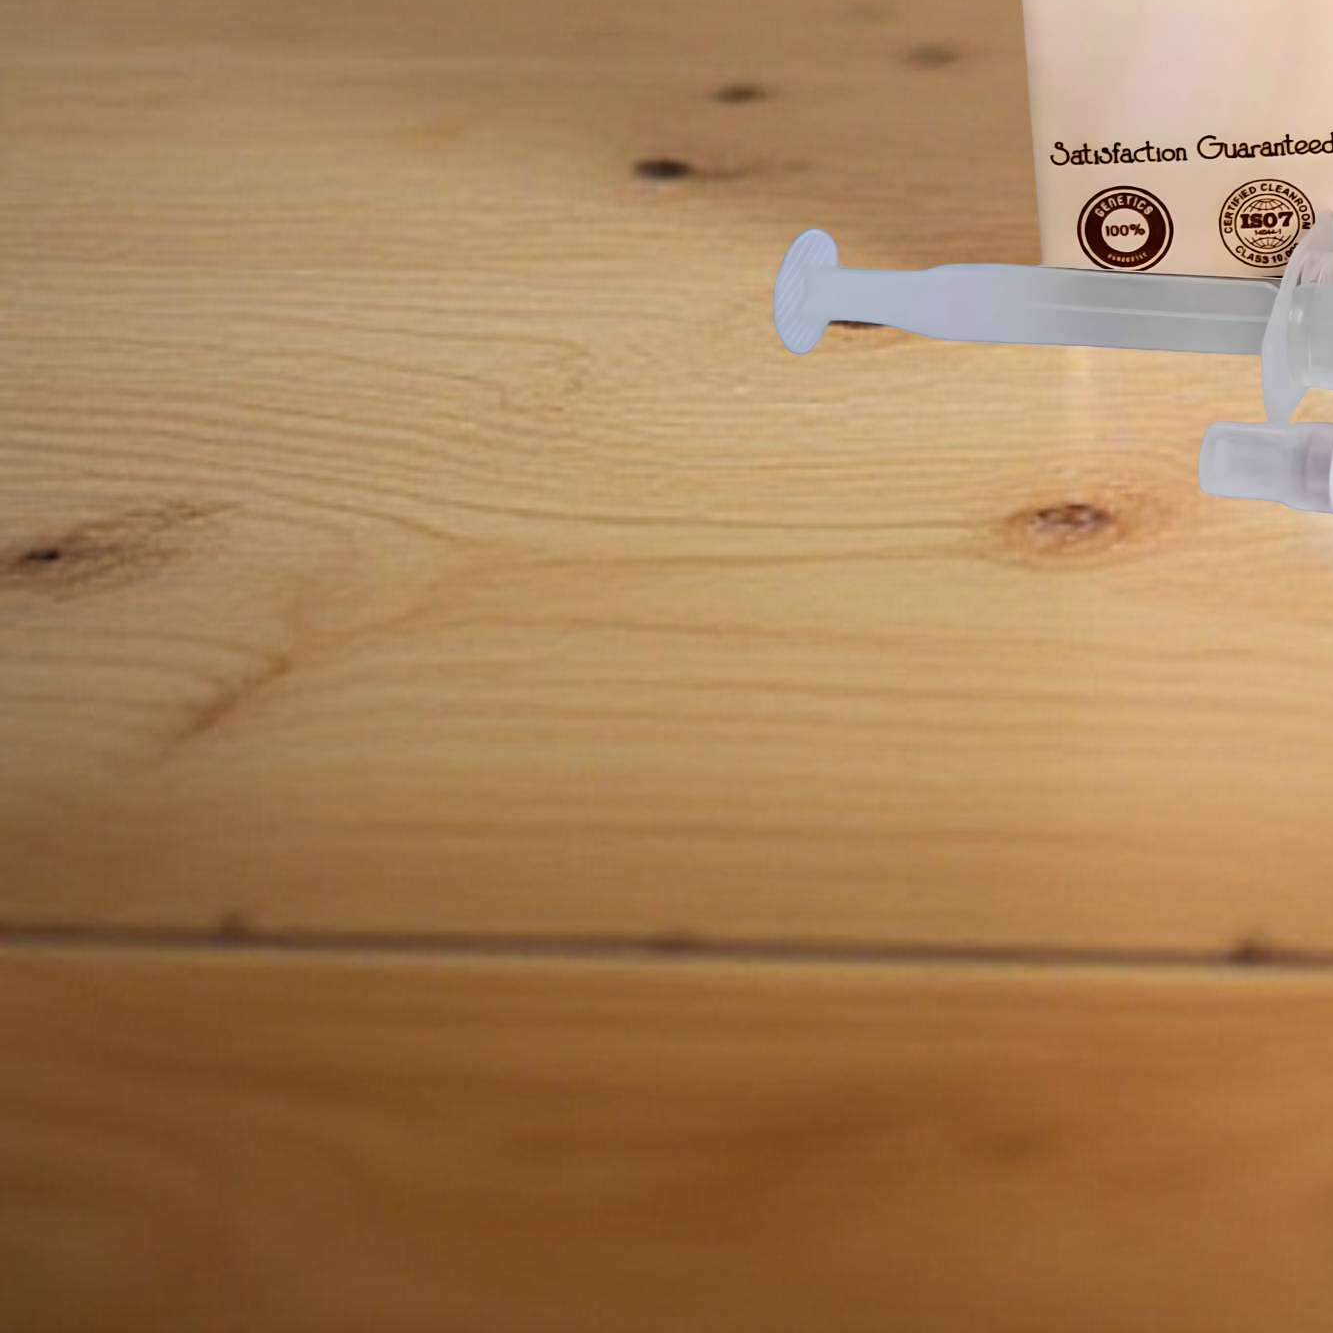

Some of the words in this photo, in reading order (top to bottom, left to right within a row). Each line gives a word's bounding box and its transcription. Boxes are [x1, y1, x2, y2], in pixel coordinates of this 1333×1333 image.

[1050, 141, 1188, 166] Satisfaction
[1094, 194, 1154, 219] GENETICS
[1223, 186, 1257, 235] CERTIFIED
[1106, 224, 1145, 236] 100%
[1235, 244, 1269, 265] CLASS
